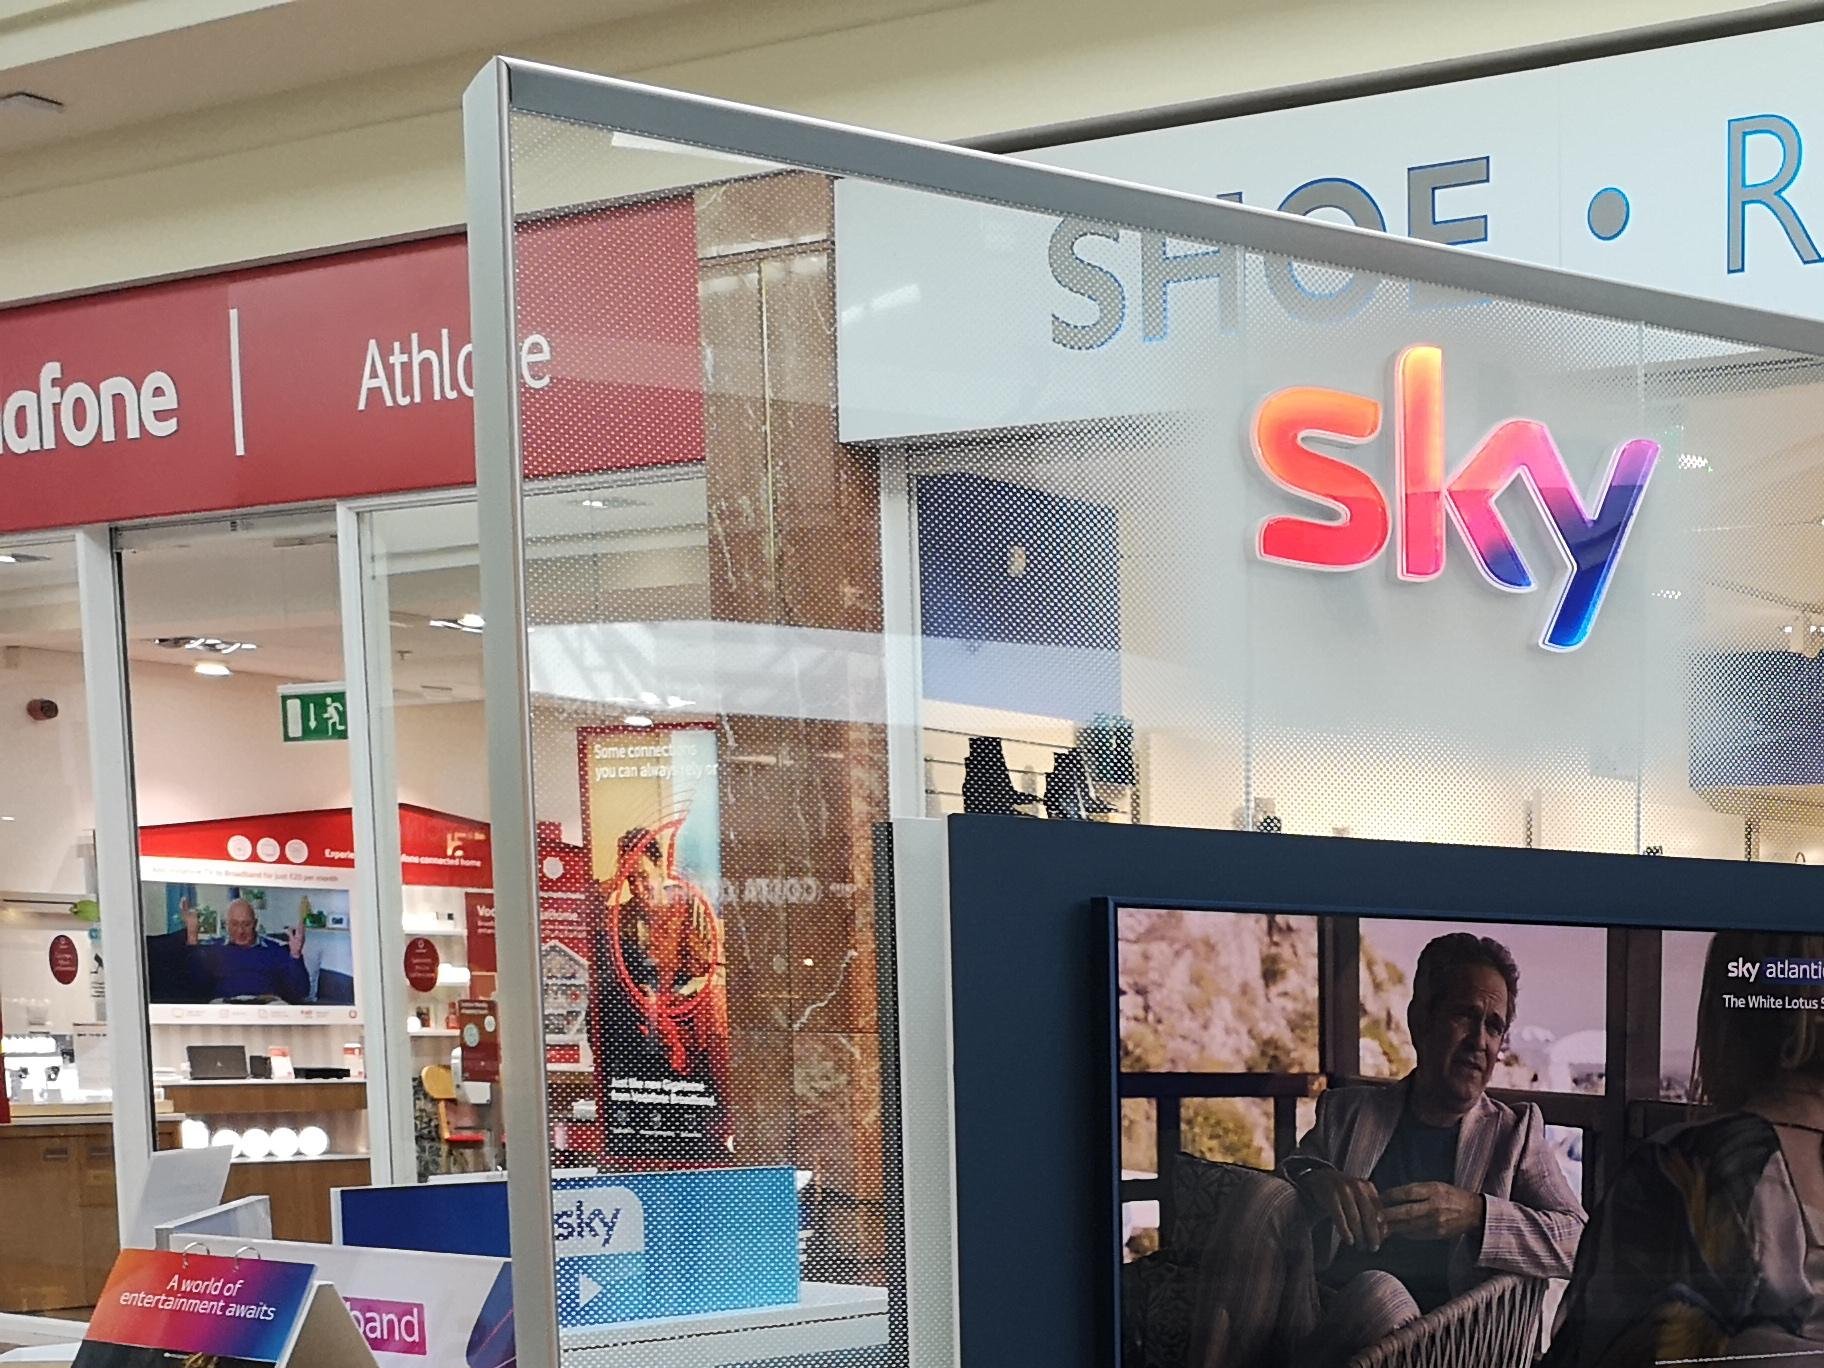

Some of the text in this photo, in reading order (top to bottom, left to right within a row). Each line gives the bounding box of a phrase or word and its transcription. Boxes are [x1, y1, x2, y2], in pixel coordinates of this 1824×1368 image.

[1048, 155, 1491, 350] SHOE
[0, 328, 551, 454] afone Athloe
[1252, 344, 1661, 654] sky
[594, 744, 626, 759] Some
[595, 764, 615, 782] you
[617, 765, 638, 778] can
[1727, 957, 1760, 983] sky
[1723, 994, 1746, 1009] The
[1748, 994, 1783, 1010] White
[1785, 996, 1819, 1010] Lotus
[554, 1200, 621, 1247] sky
[166, 1274, 244, 1297] A world of
[119, 1290, 277, 1321] entertainment awaits
